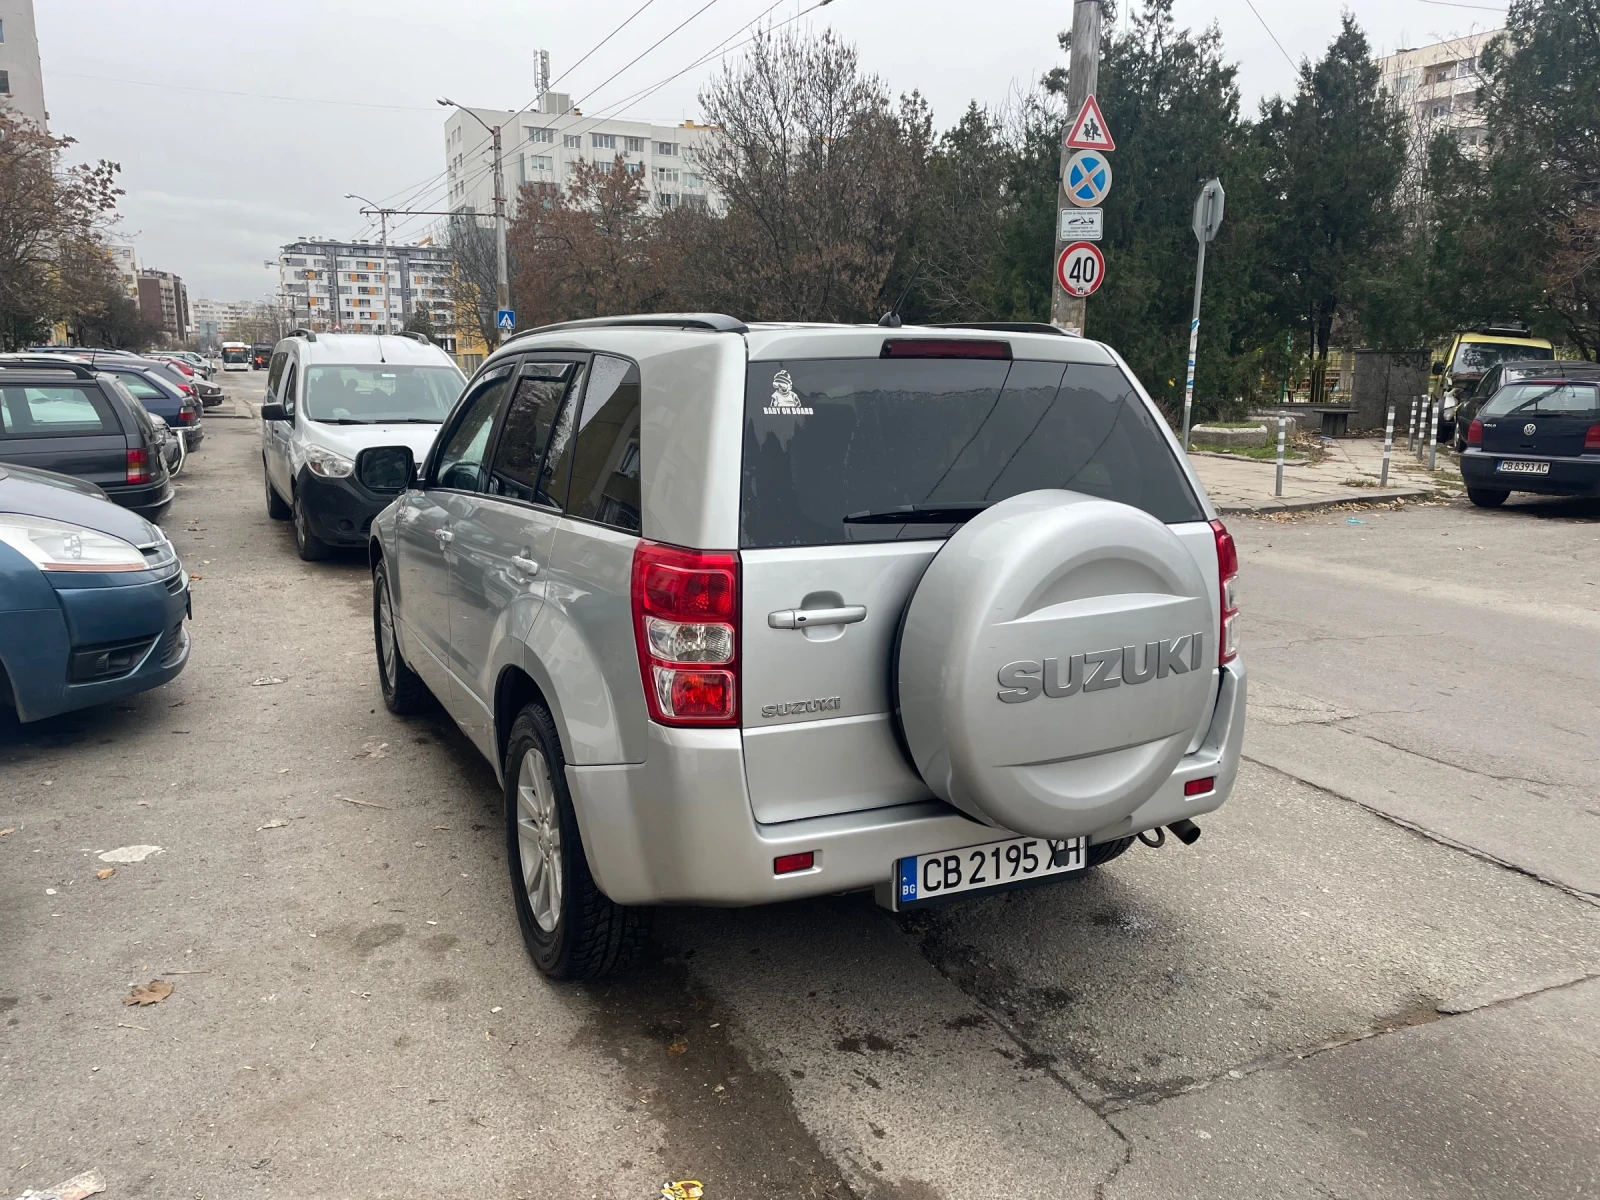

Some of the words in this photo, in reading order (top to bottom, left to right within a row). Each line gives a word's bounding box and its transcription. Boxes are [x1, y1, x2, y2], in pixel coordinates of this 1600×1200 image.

[1069, 256, 1095, 283] 40
[1502, 461, 1513, 471] CB
[1514, 462, 1535, 472] 8393
[1536, 463, 1548, 472] AC
[997, 631, 1203, 704] SUZUKI
[761, 696, 841, 718] SUZUKI
[923, 855, 962, 892] CB
[969, 841, 1039, 885] 2195
[902, 884, 916, 896] BG
